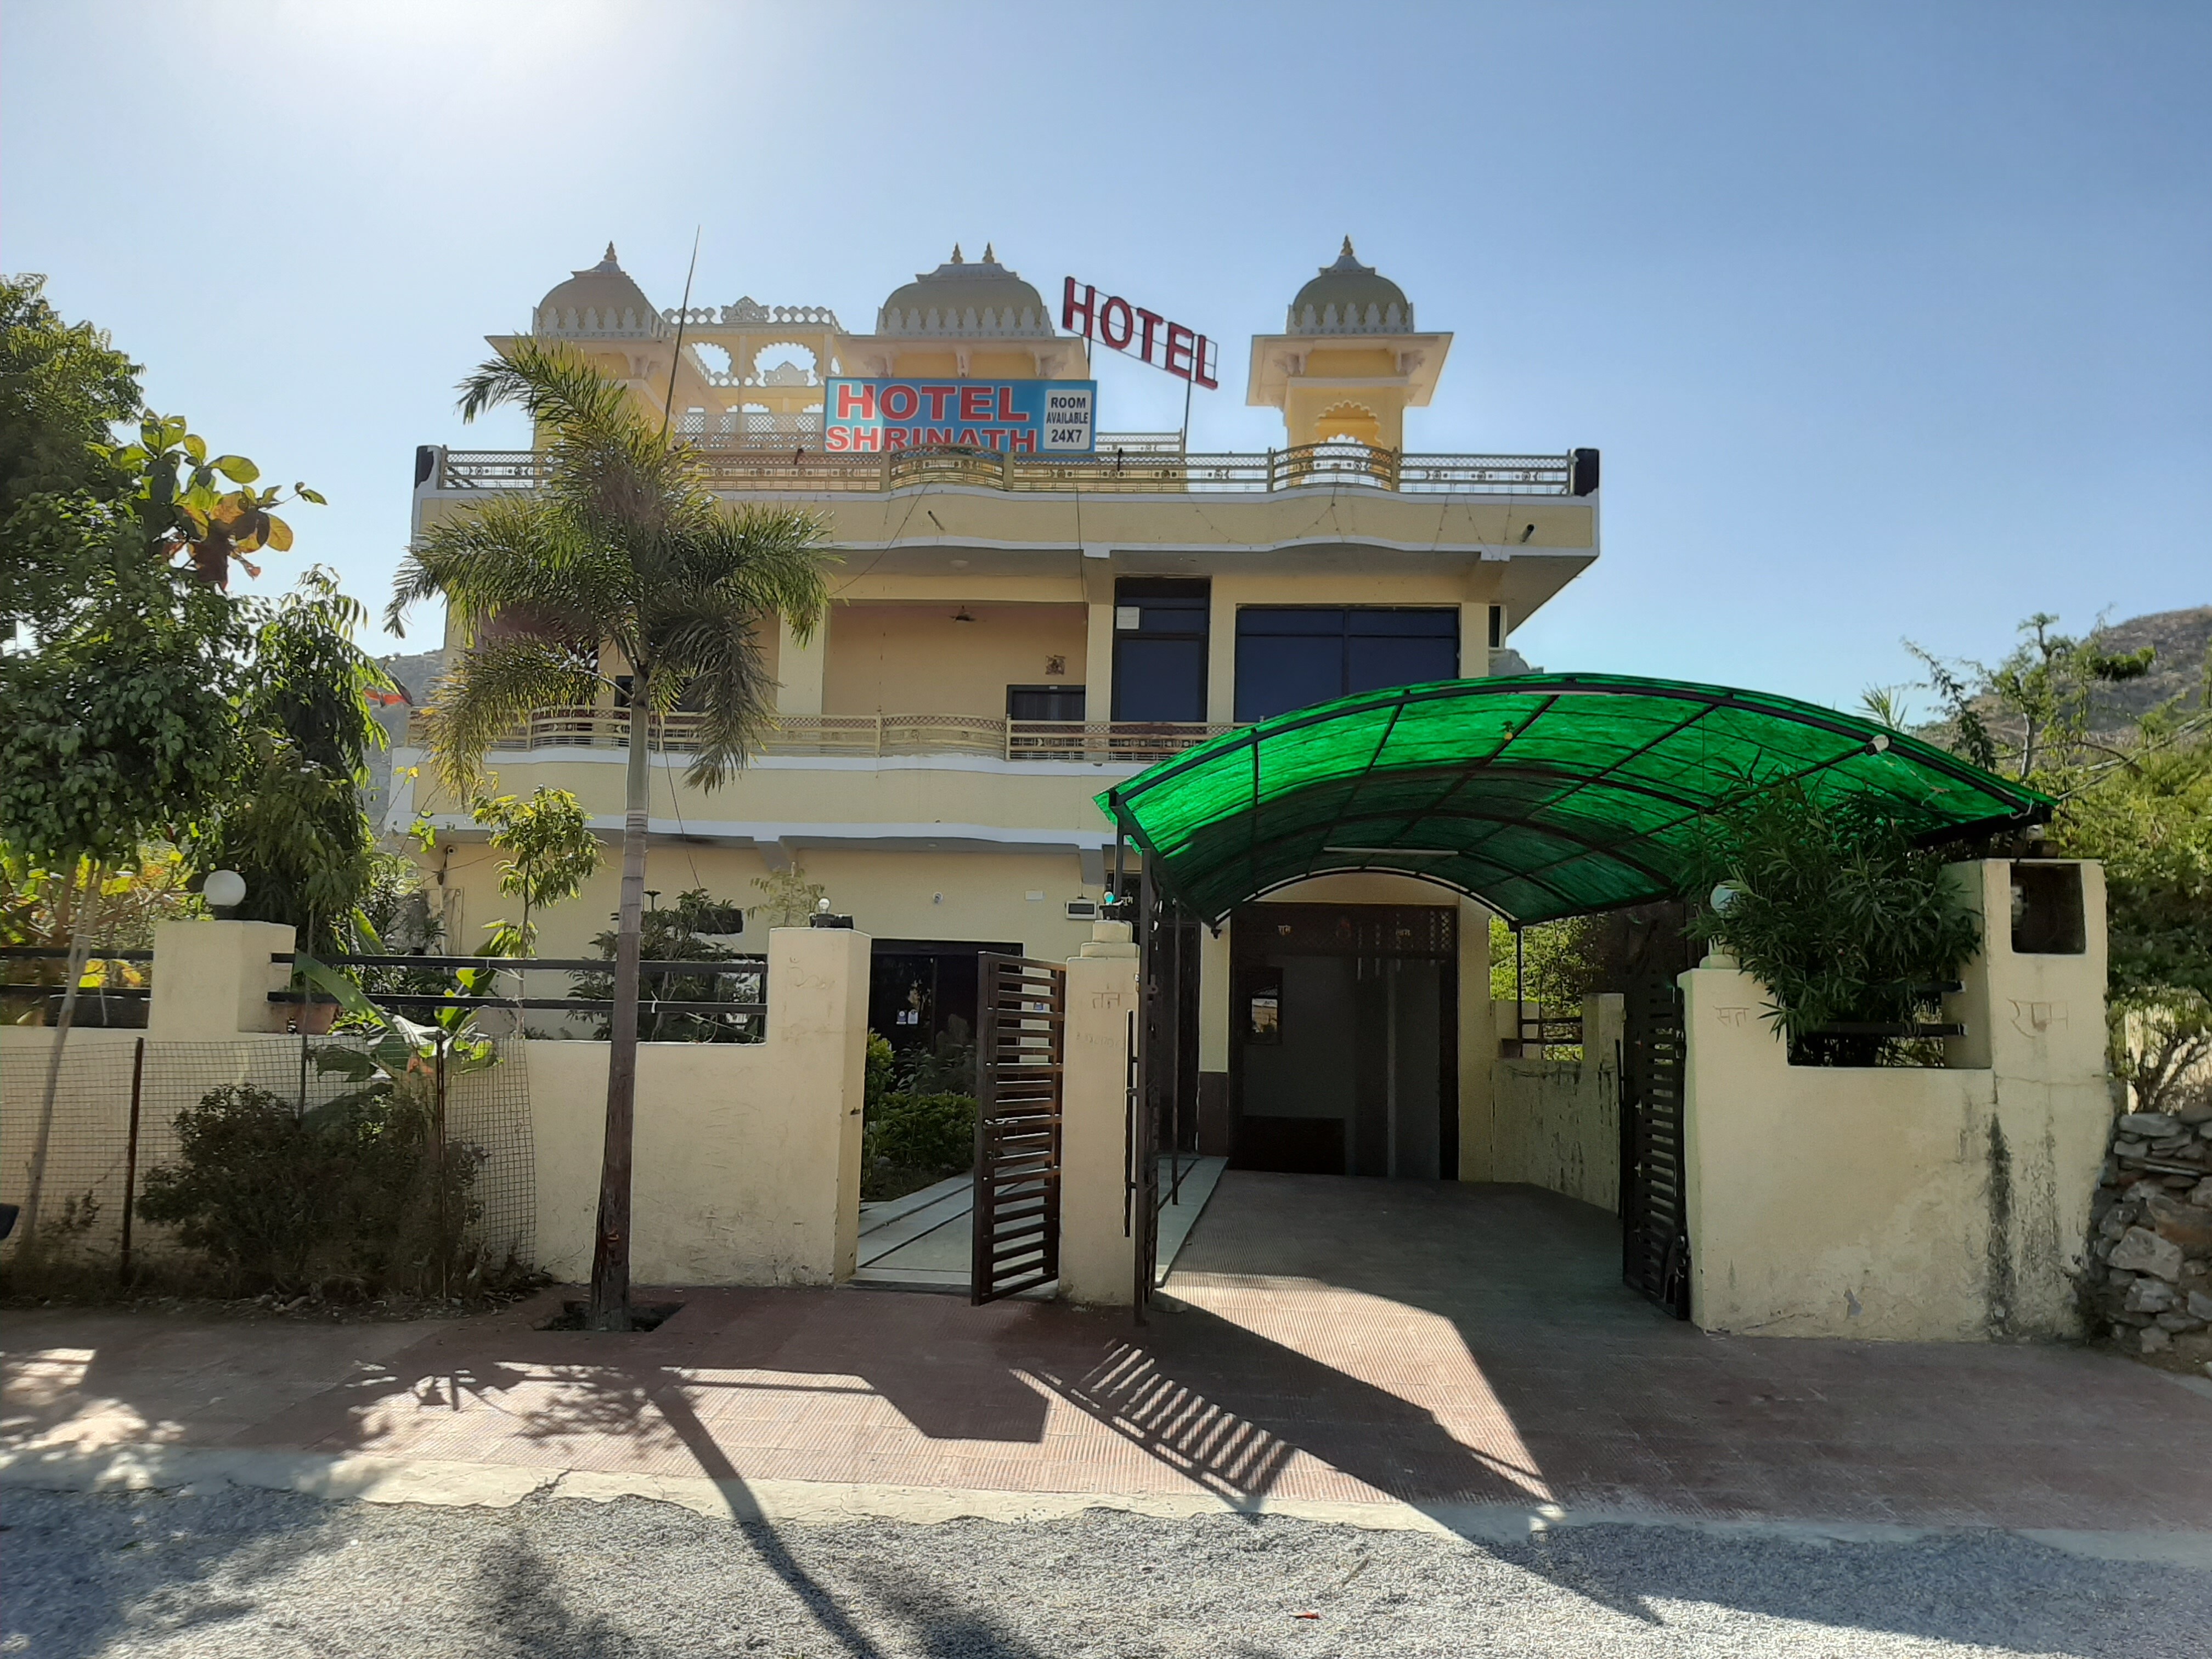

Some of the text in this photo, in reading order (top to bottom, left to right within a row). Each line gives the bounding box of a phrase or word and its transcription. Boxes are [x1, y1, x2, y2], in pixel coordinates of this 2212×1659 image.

[1062, 276, 1218, 391] HOTEL
[837, 383, 1029, 422] HOTEL
[1051, 397, 1086, 409] ROOM
[1046, 411, 1088, 424] AVAILABLE
[825, 425, 1037, 453] SHRINATH
[1051, 428, 1082, 443] 24X7
